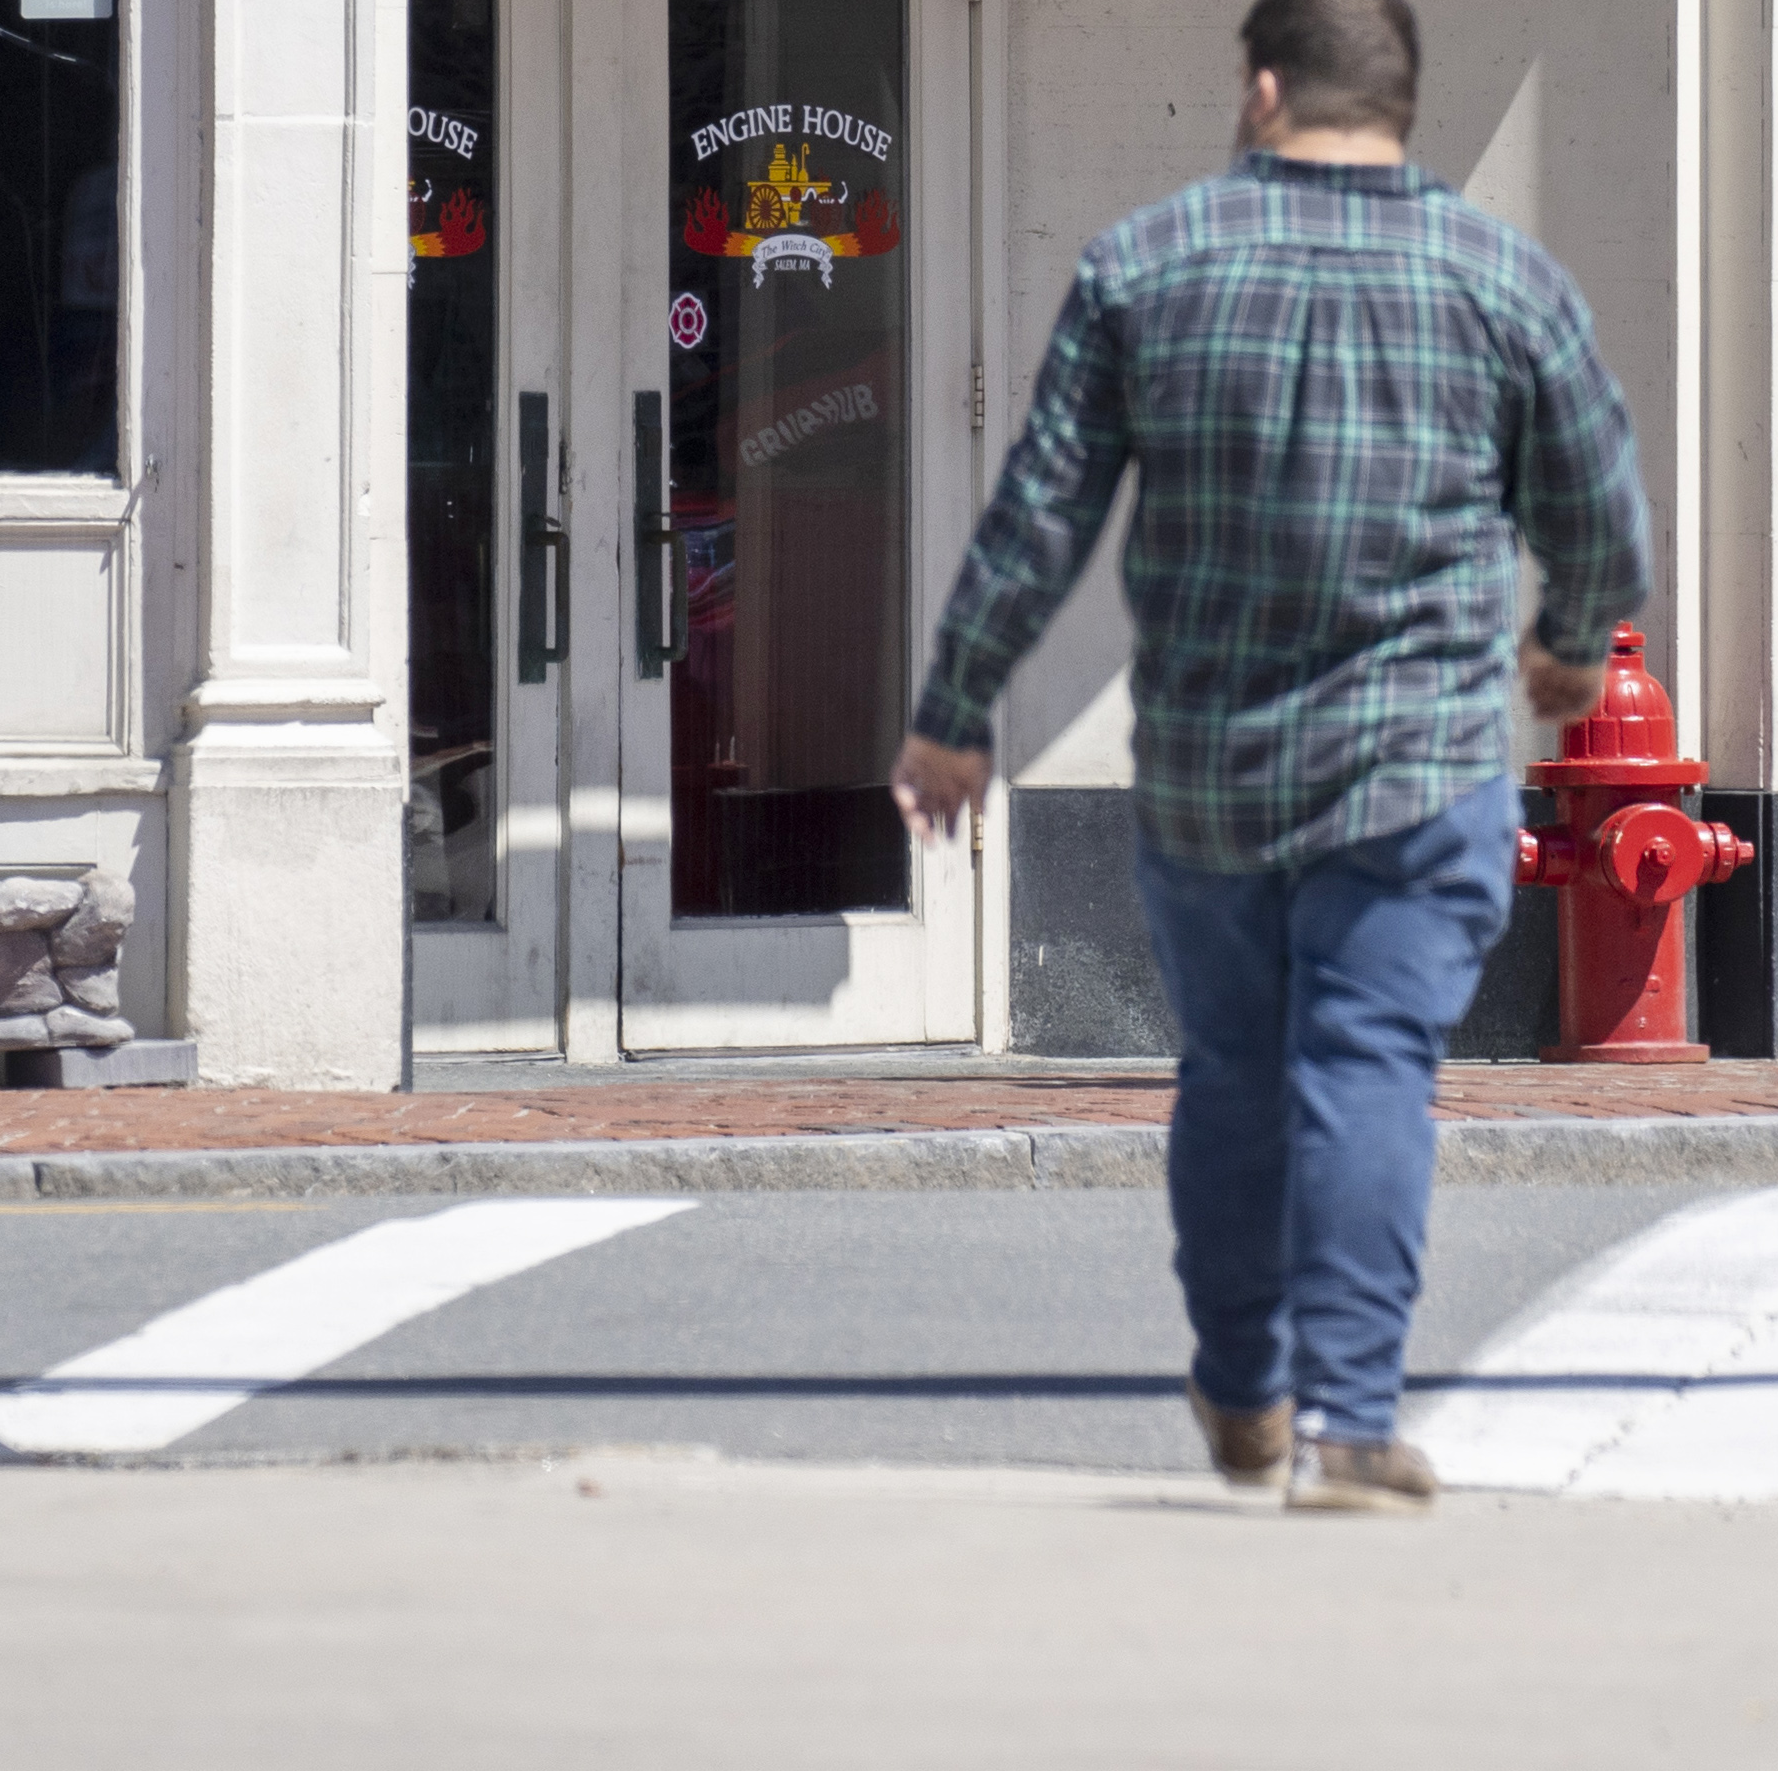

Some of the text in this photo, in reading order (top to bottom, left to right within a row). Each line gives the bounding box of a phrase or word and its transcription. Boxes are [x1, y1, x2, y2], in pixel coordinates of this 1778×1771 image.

[407, 106, 478, 160] OUSE
[691, 104, 892, 162] ENGINE HOUSE
[761, 239, 829, 259] The Witch City
[798, 259, 811, 271] MA
